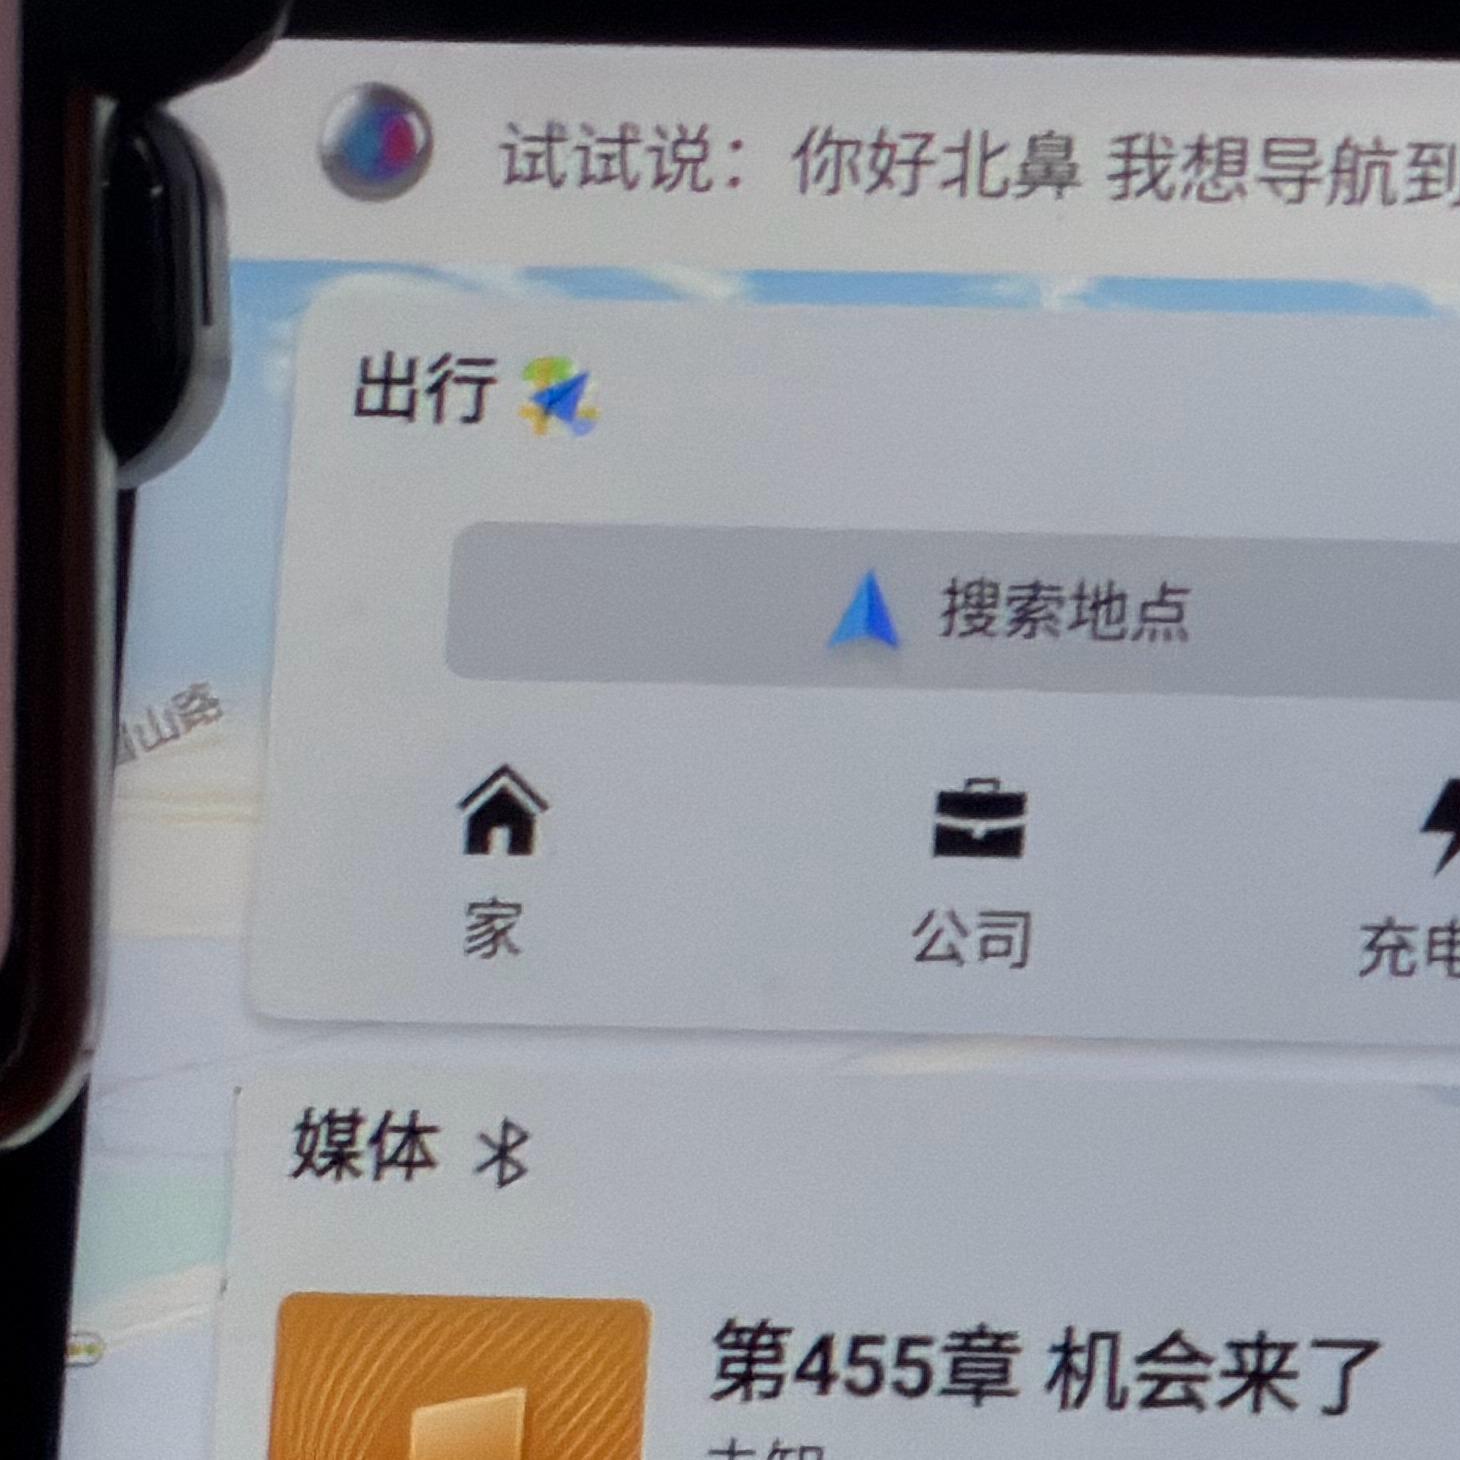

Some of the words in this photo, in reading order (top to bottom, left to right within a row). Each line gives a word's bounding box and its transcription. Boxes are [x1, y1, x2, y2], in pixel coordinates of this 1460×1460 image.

[353, 350, 498, 425] 出行
[939, 577, 1191, 644] 搜索地点
[119, 683, 223, 764] 山路
[464, 896, 523, 960] 家
[911, 909, 1032, 970] 公司
[290, 1106, 440, 1184] 媒体
[709, 1318, 1022, 1408] 第455章
[1044, 1325, 1382, 1417] 机会来了
